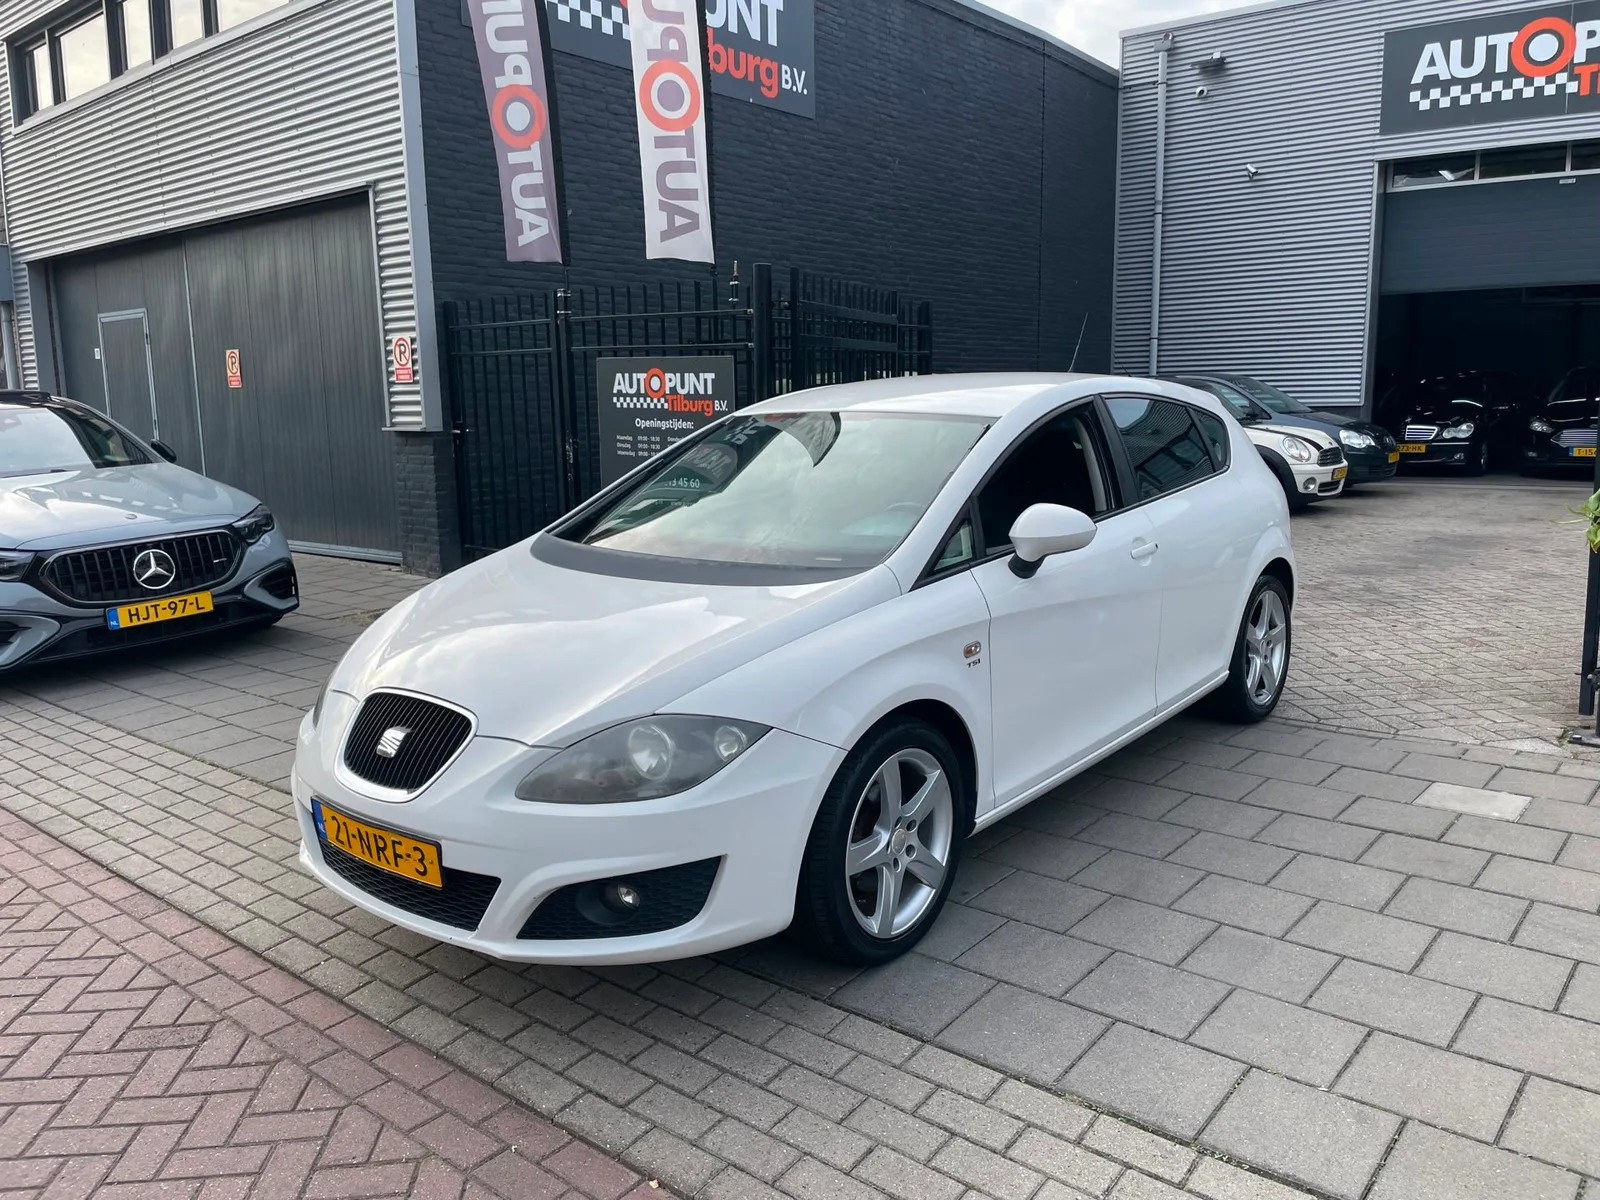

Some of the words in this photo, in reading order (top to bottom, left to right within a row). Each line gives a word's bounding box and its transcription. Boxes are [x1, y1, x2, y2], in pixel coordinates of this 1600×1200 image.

[706, 0, 784, 47] UNT
[706, 27, 779, 99] burg
[781, 64, 808, 95] B.V.
[612, 367, 716, 399] AUTOPUNT
[665, 394, 714, 417] Tilburg
[714, 400, 729, 411] B.V.
[635, 417, 694, 431] Openingstijden:
[689, 478, 700, 488] 60
[128, 597, 205, 623] HJT-97-L
[331, 815, 428, 877] 21-NRF-3
